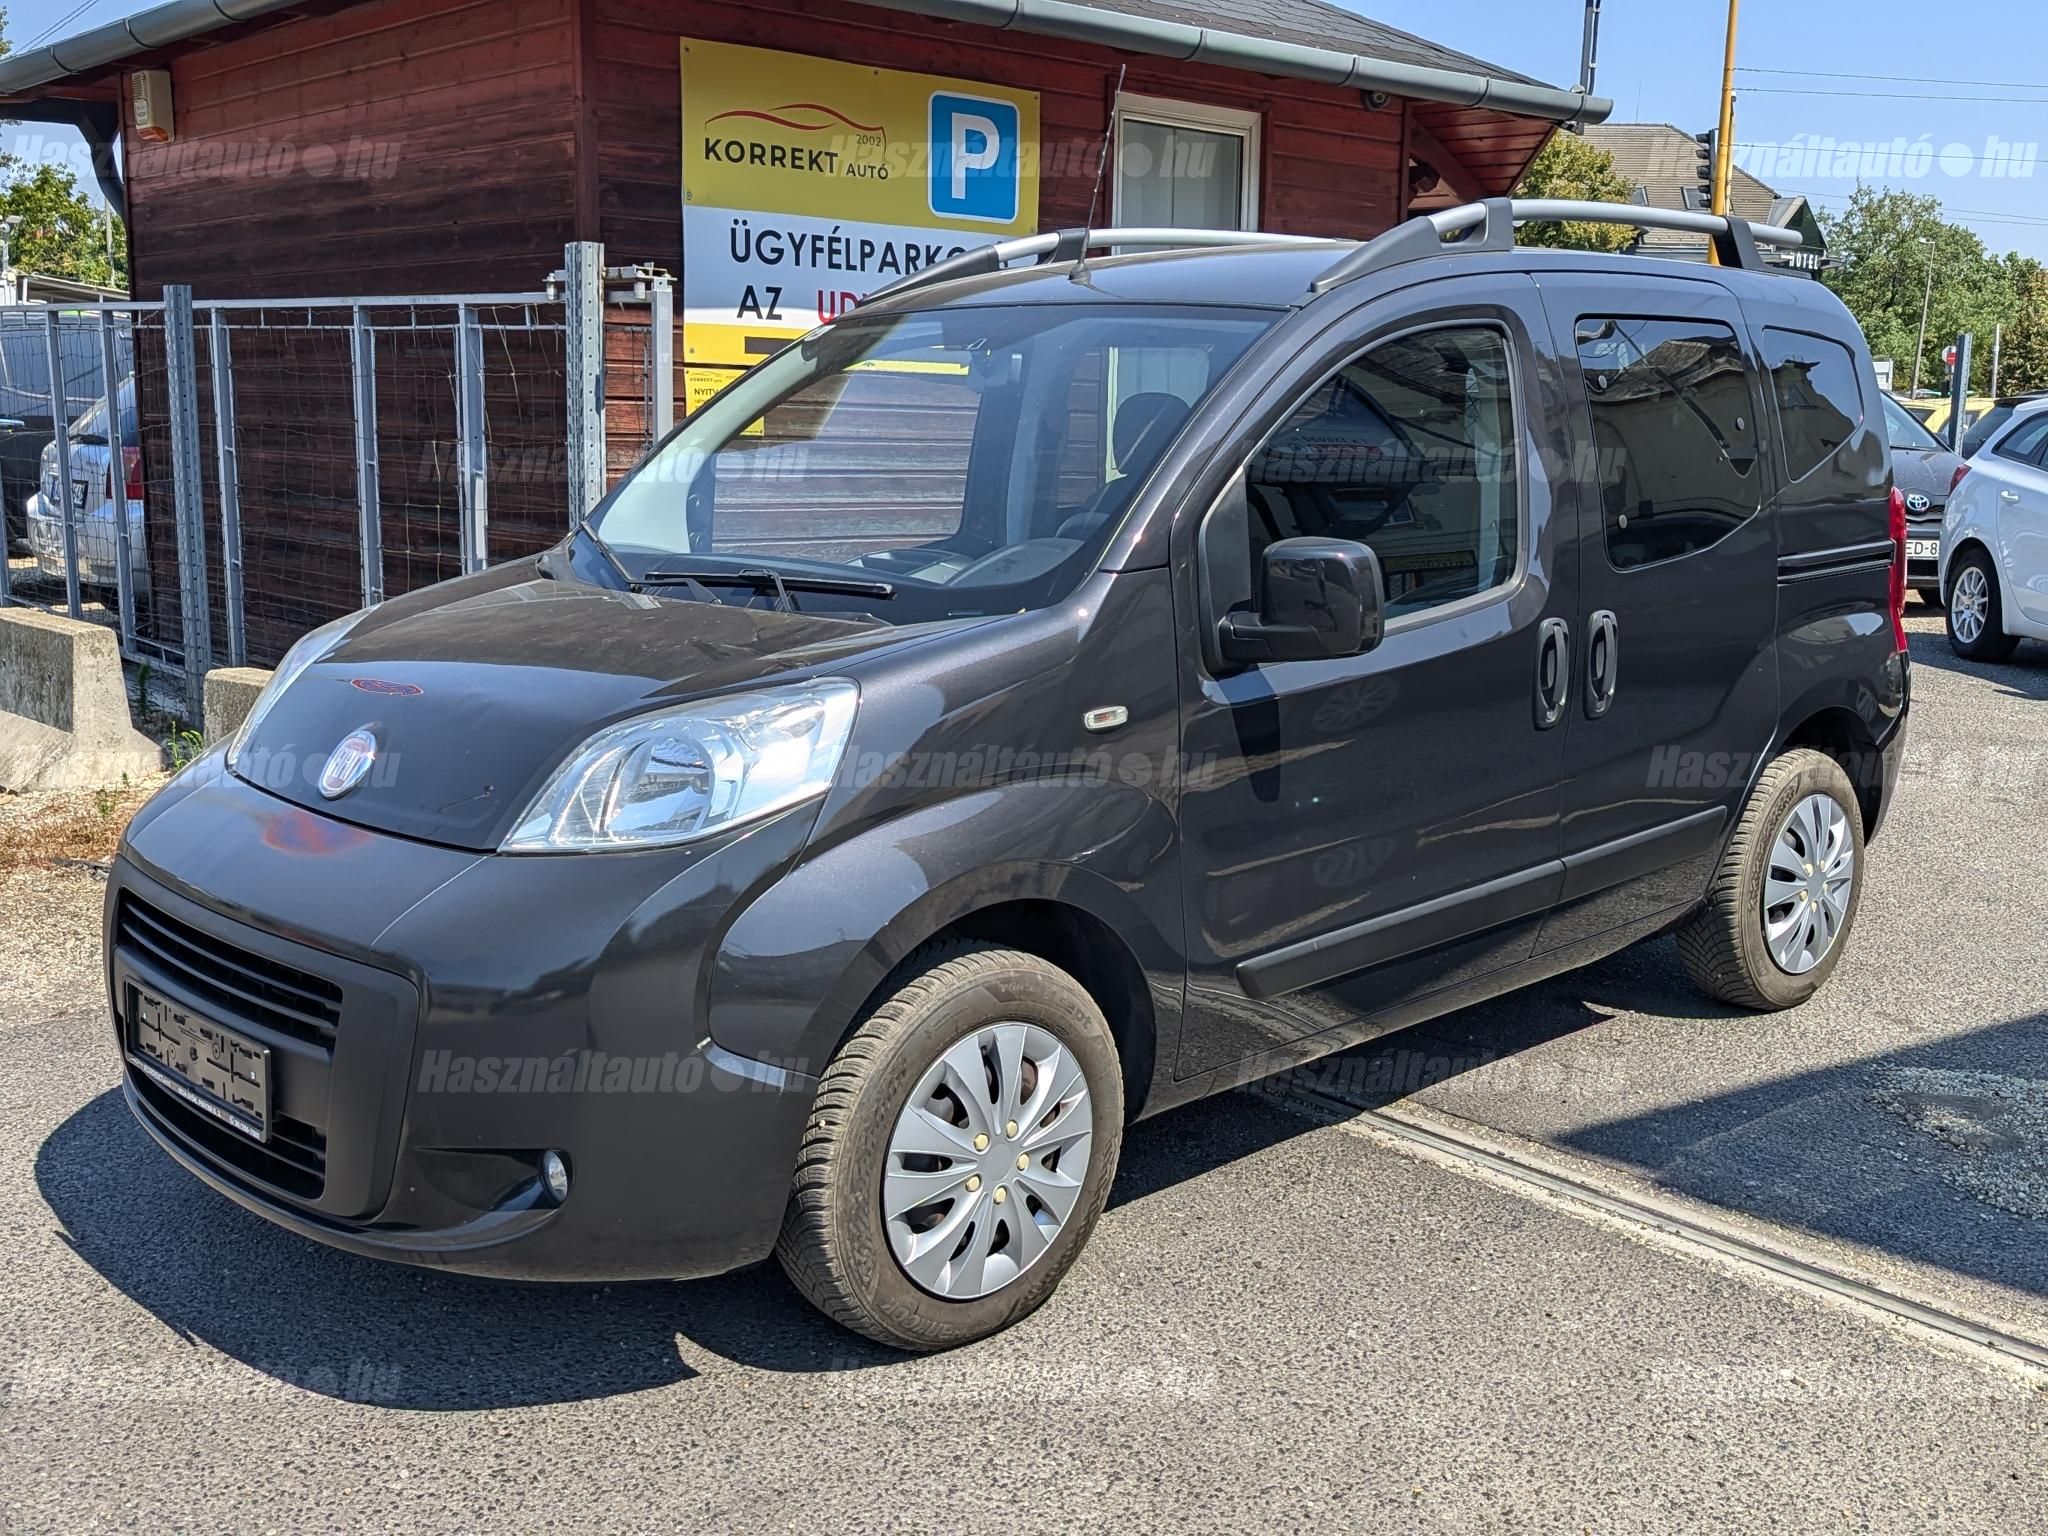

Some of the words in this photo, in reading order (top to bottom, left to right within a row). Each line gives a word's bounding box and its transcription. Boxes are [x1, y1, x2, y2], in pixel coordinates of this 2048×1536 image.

[704, 137, 838, 174] KORREKT
[846, 163, 889, 180] AUTÓ
[856, 134, 882, 147] 2002
[952, 111, 999, 200] P
[1789, 252, 1818, 270] HOTEL
[736, 285, 783, 321] AZ
